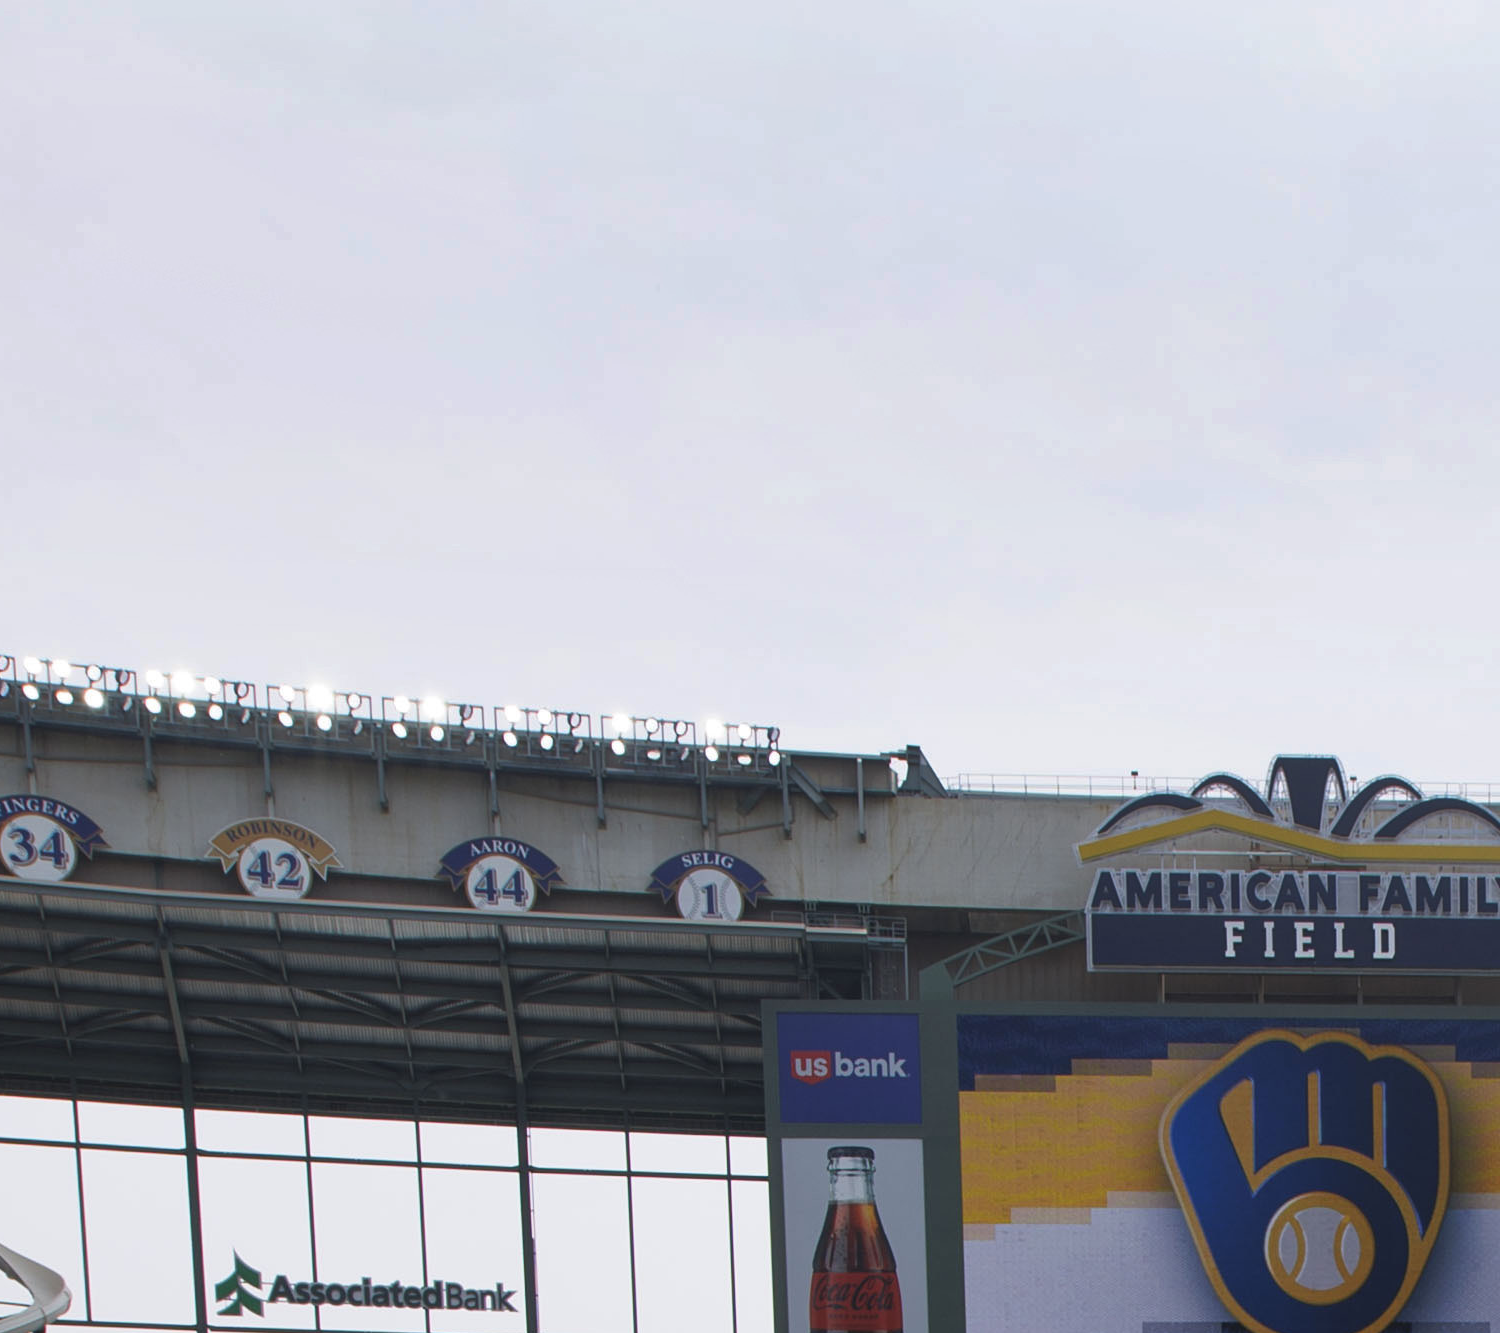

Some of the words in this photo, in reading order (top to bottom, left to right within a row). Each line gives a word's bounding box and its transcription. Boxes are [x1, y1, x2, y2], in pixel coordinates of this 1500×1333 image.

[6, 826, 69, 871] 34
[225, 819, 323, 851] ROBINSON
[469, 838, 531, 861] AARON
[246, 849, 304, 889] 42
[680, 851, 736, 871] SELIG
[473, 867, 529, 907] 44
[701, 882, 723, 920] 1
[1089, 869, 1338, 912] AMERICAN
[1223, 920, 1396, 960] FIELD
[794, 1057, 829, 1077] us
[834, 1051, 910, 1078] bank
